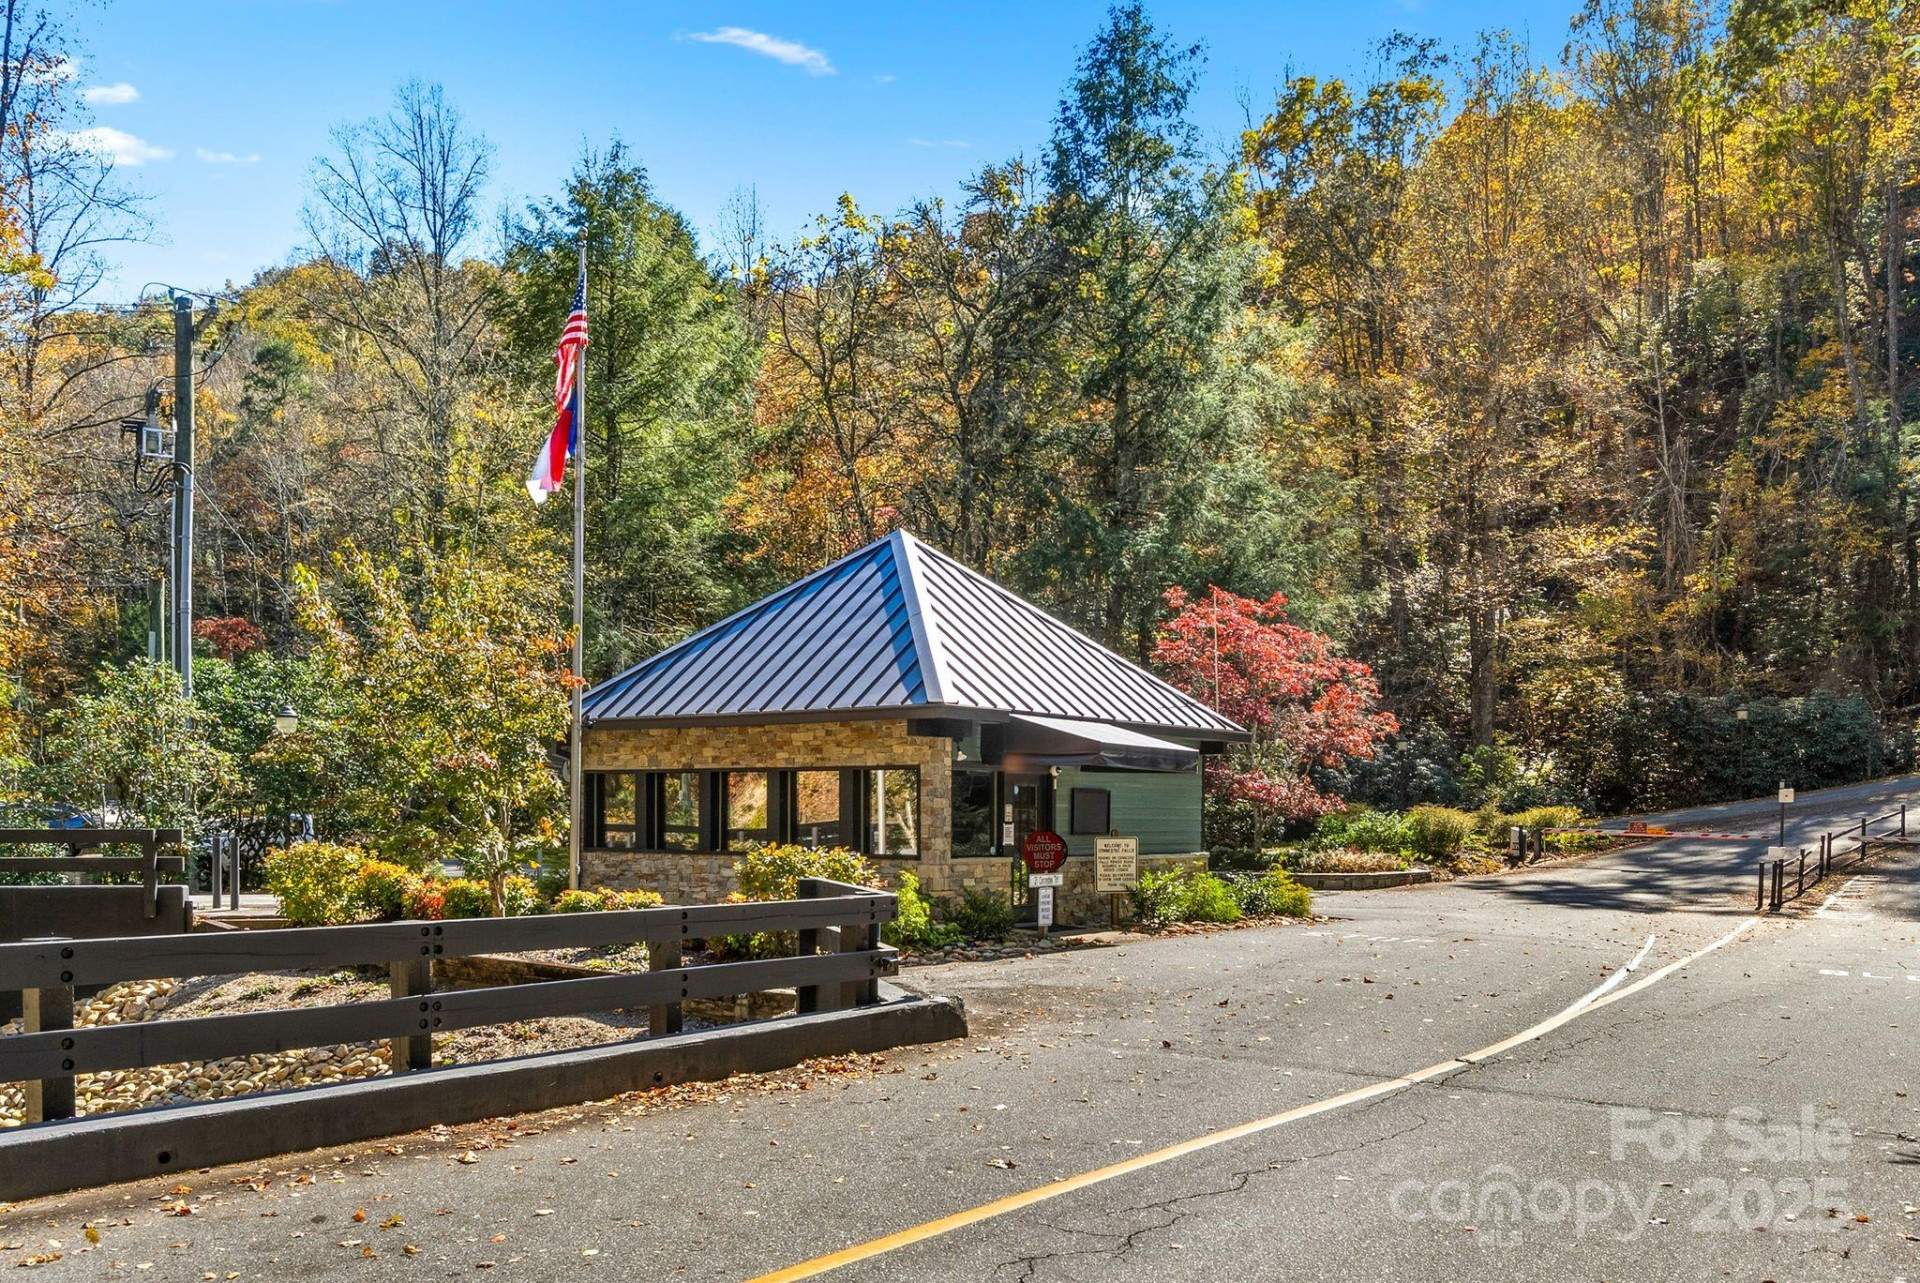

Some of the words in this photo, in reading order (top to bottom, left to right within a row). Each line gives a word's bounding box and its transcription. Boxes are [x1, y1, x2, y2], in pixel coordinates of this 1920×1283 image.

[1036, 835, 1051, 843] ALL
[1026, 843, 1062, 851] VISITORS
[1033, 851, 1055, 860] MUST
[1034, 860, 1055, 868] STOP
